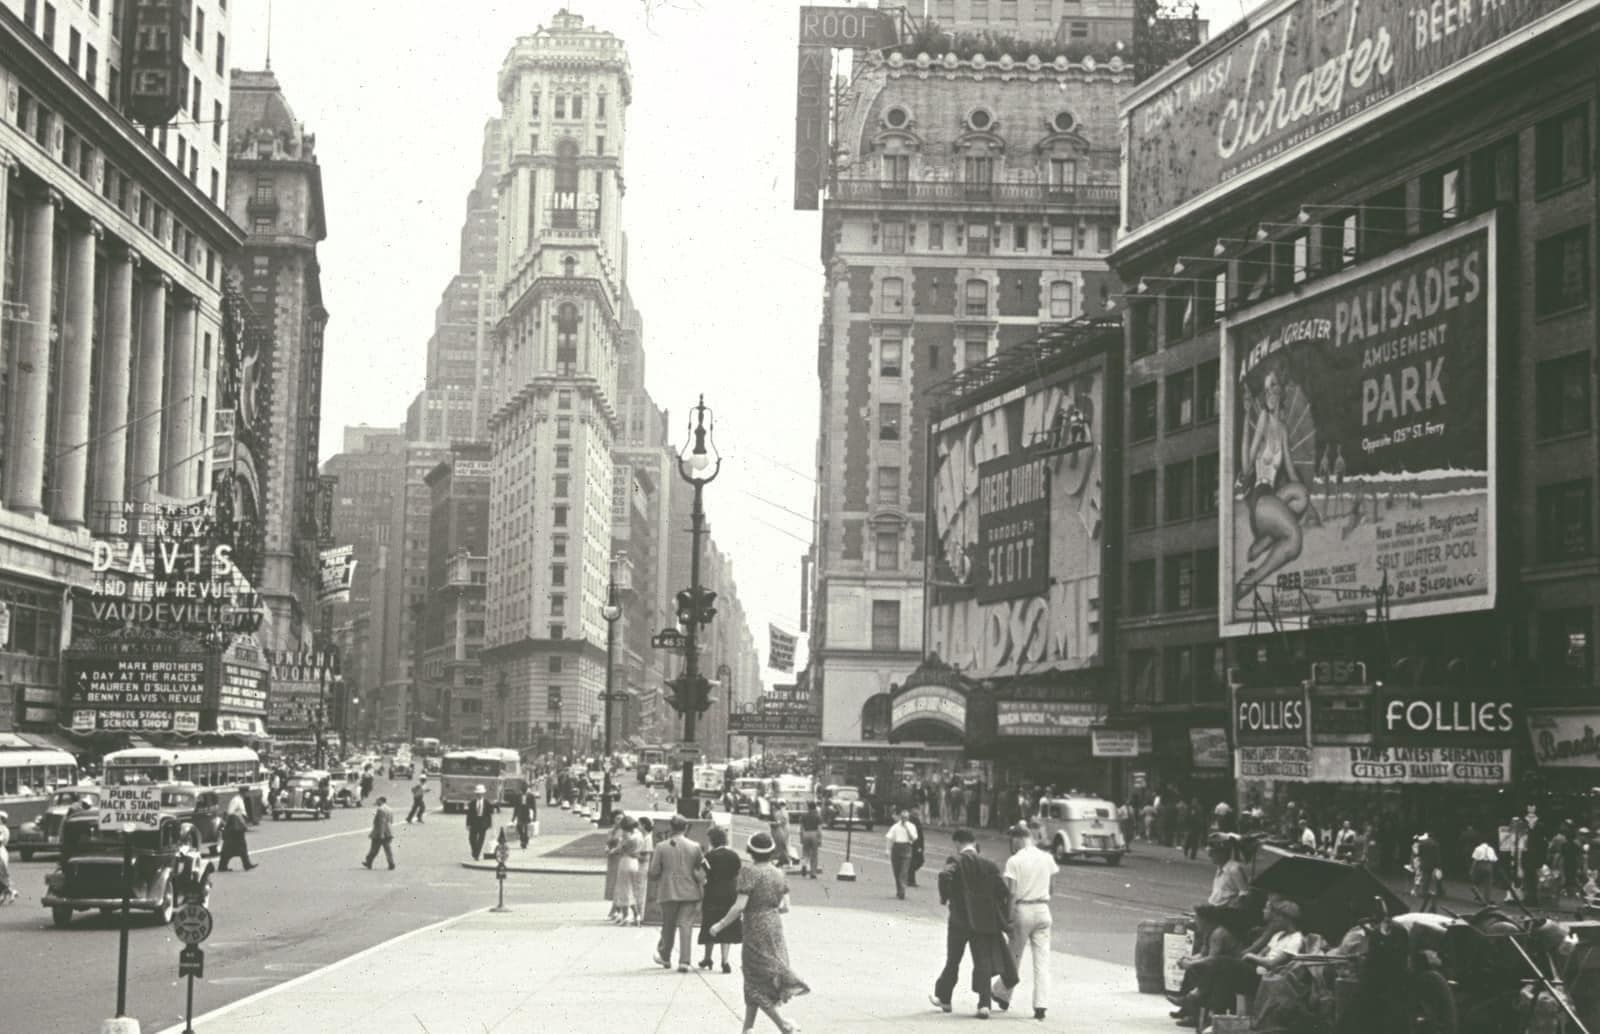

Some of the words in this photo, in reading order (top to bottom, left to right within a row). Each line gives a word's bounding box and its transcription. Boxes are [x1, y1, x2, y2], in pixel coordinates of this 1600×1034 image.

[804, 15, 876, 38] ROOF
[1319, 112, 1342, 131] LOST
[1239, 360, 1247, 381] A
[1248, 337, 1269, 370] NEW
[1284, 319, 1331, 345] GREATER
[1335, 251, 1480, 346] PALISADES
[1363, 324, 1448, 368] AMUSEMENT
[1362, 357, 1447, 425] PARK
[1362, 437, 1391, 453] Opposite
[1425, 421, 1445, 436] Ferry
[980, 470, 1009, 515] IRENE
[1429, 507, 1479, 532] Playground
[988, 520, 1034, 541] RANDOLPH
[92, 540, 233, 575] DAVIS
[988, 538, 1034, 586] SCOTT
[1404, 546, 1441, 567] WATER
[1446, 541, 1478, 560] POOL
[92, 581, 126, 596] AND
[133, 581, 167, 597] NEW
[176, 582, 233, 598] REVUE
[1397, 581, 1416, 597] BOB
[91, 601, 235, 624] VAUDEVILLE
[663, 639, 674, 647] 46
[80, 672, 87, 680] A
[93, 672, 114, 680] DAY
[121, 672, 133, 681] AT
[140, 672, 158, 681] THE
[163, 673, 197, 682] RACES
[118, 662, 147, 671] MARX
[152, 662, 204, 672] BROTHERS
[91, 682, 139, 692] MAUREEN
[144, 683, 204, 692] O'SULLIVAN
[88, 693, 120, 702] BENNY
[126, 694, 158, 702] DAVIS
[168, 694, 202, 704] REVUE
[142, 719, 170, 728] SHOW
[1239, 700, 1303, 730] FOLLIES
[1386, 700, 1513, 732] FOLLIES
[1354, 763, 1403, 778] GIRLS
[1455, 765, 1502, 778] GIRLS
[101, 800, 127, 810] HACK
[130, 800, 160, 811] STAND
[109, 790, 152, 800] PUBLIC
[101, 812, 112, 823] 4
[116, 811, 158, 826] TAXICABS
